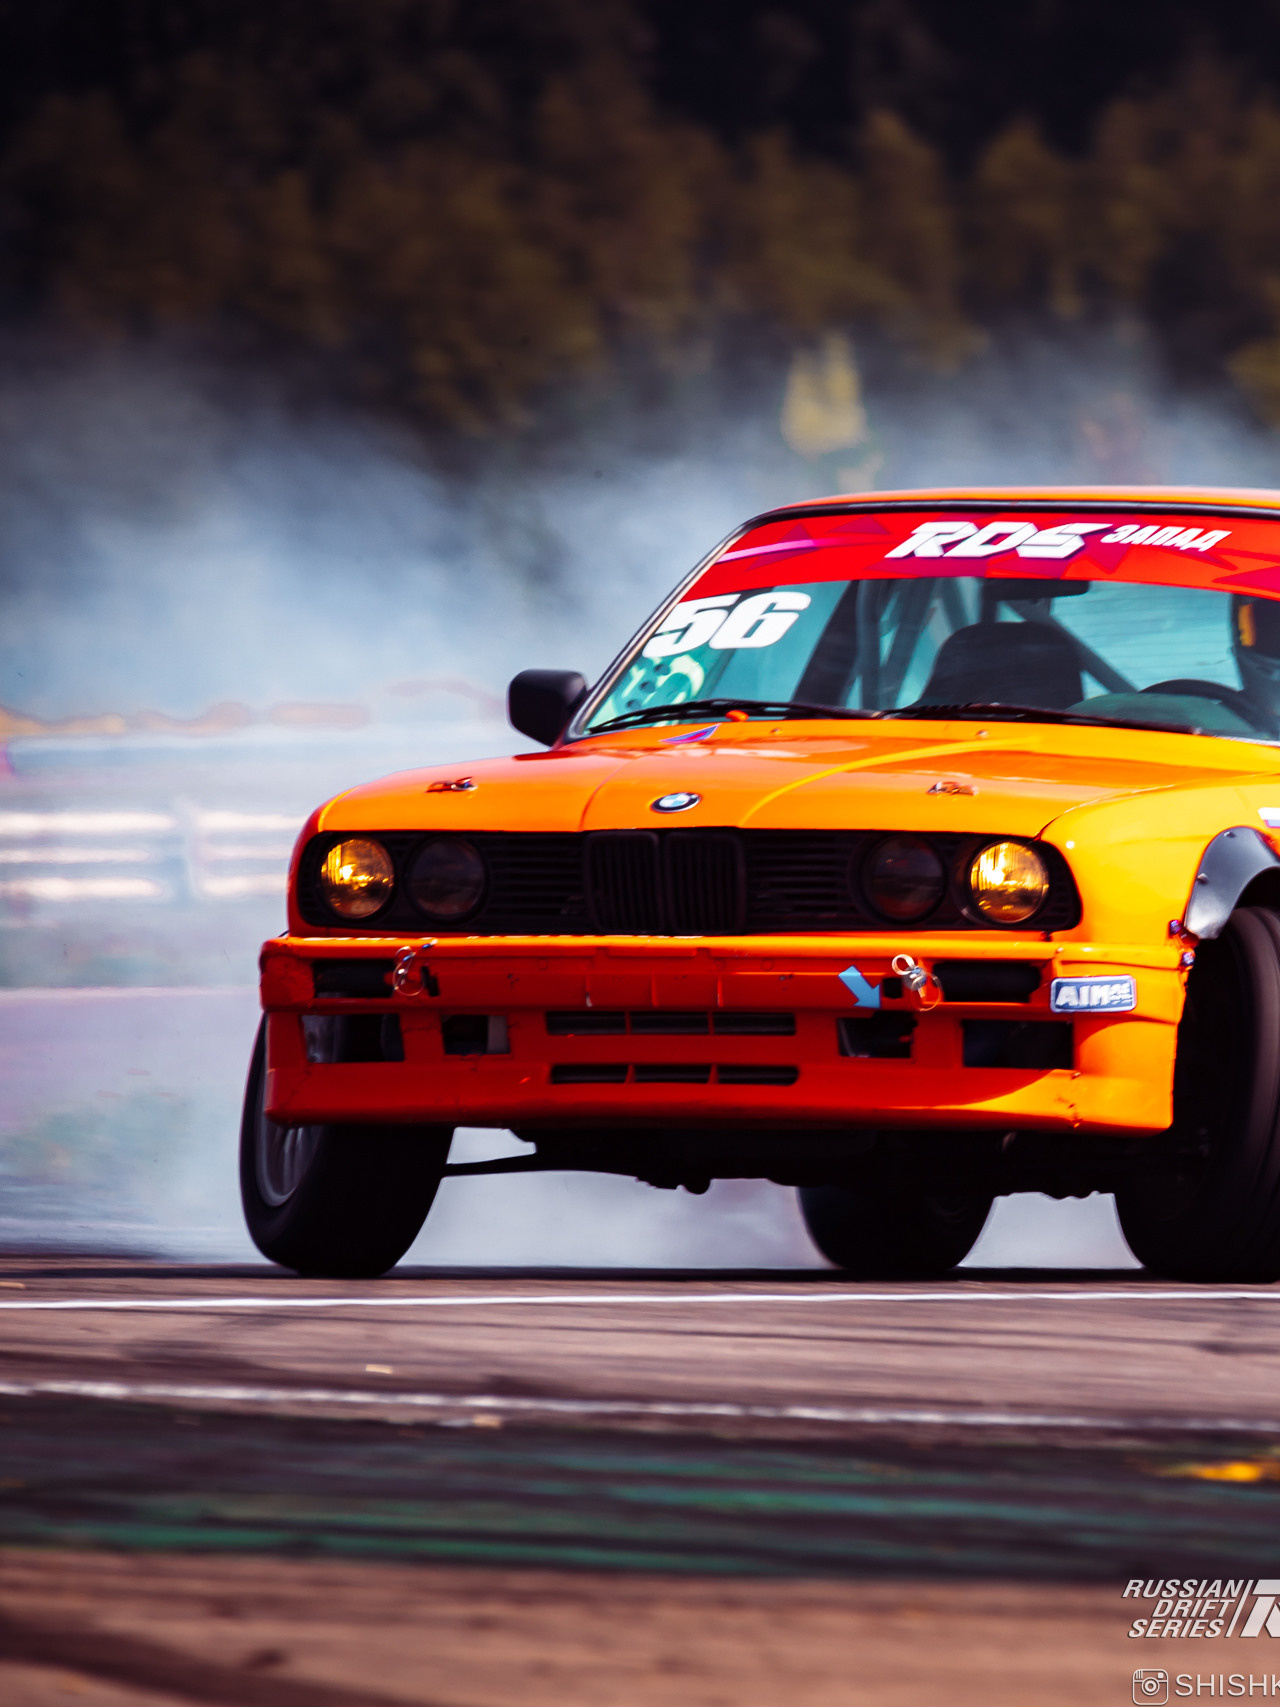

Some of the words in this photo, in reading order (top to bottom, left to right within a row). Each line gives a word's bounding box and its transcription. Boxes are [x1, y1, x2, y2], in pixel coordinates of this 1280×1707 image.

[884, 521, 1114, 559] RDS
[1100, 524, 1233, 552] ЗАПАД
[642, 591, 812, 659] 56
